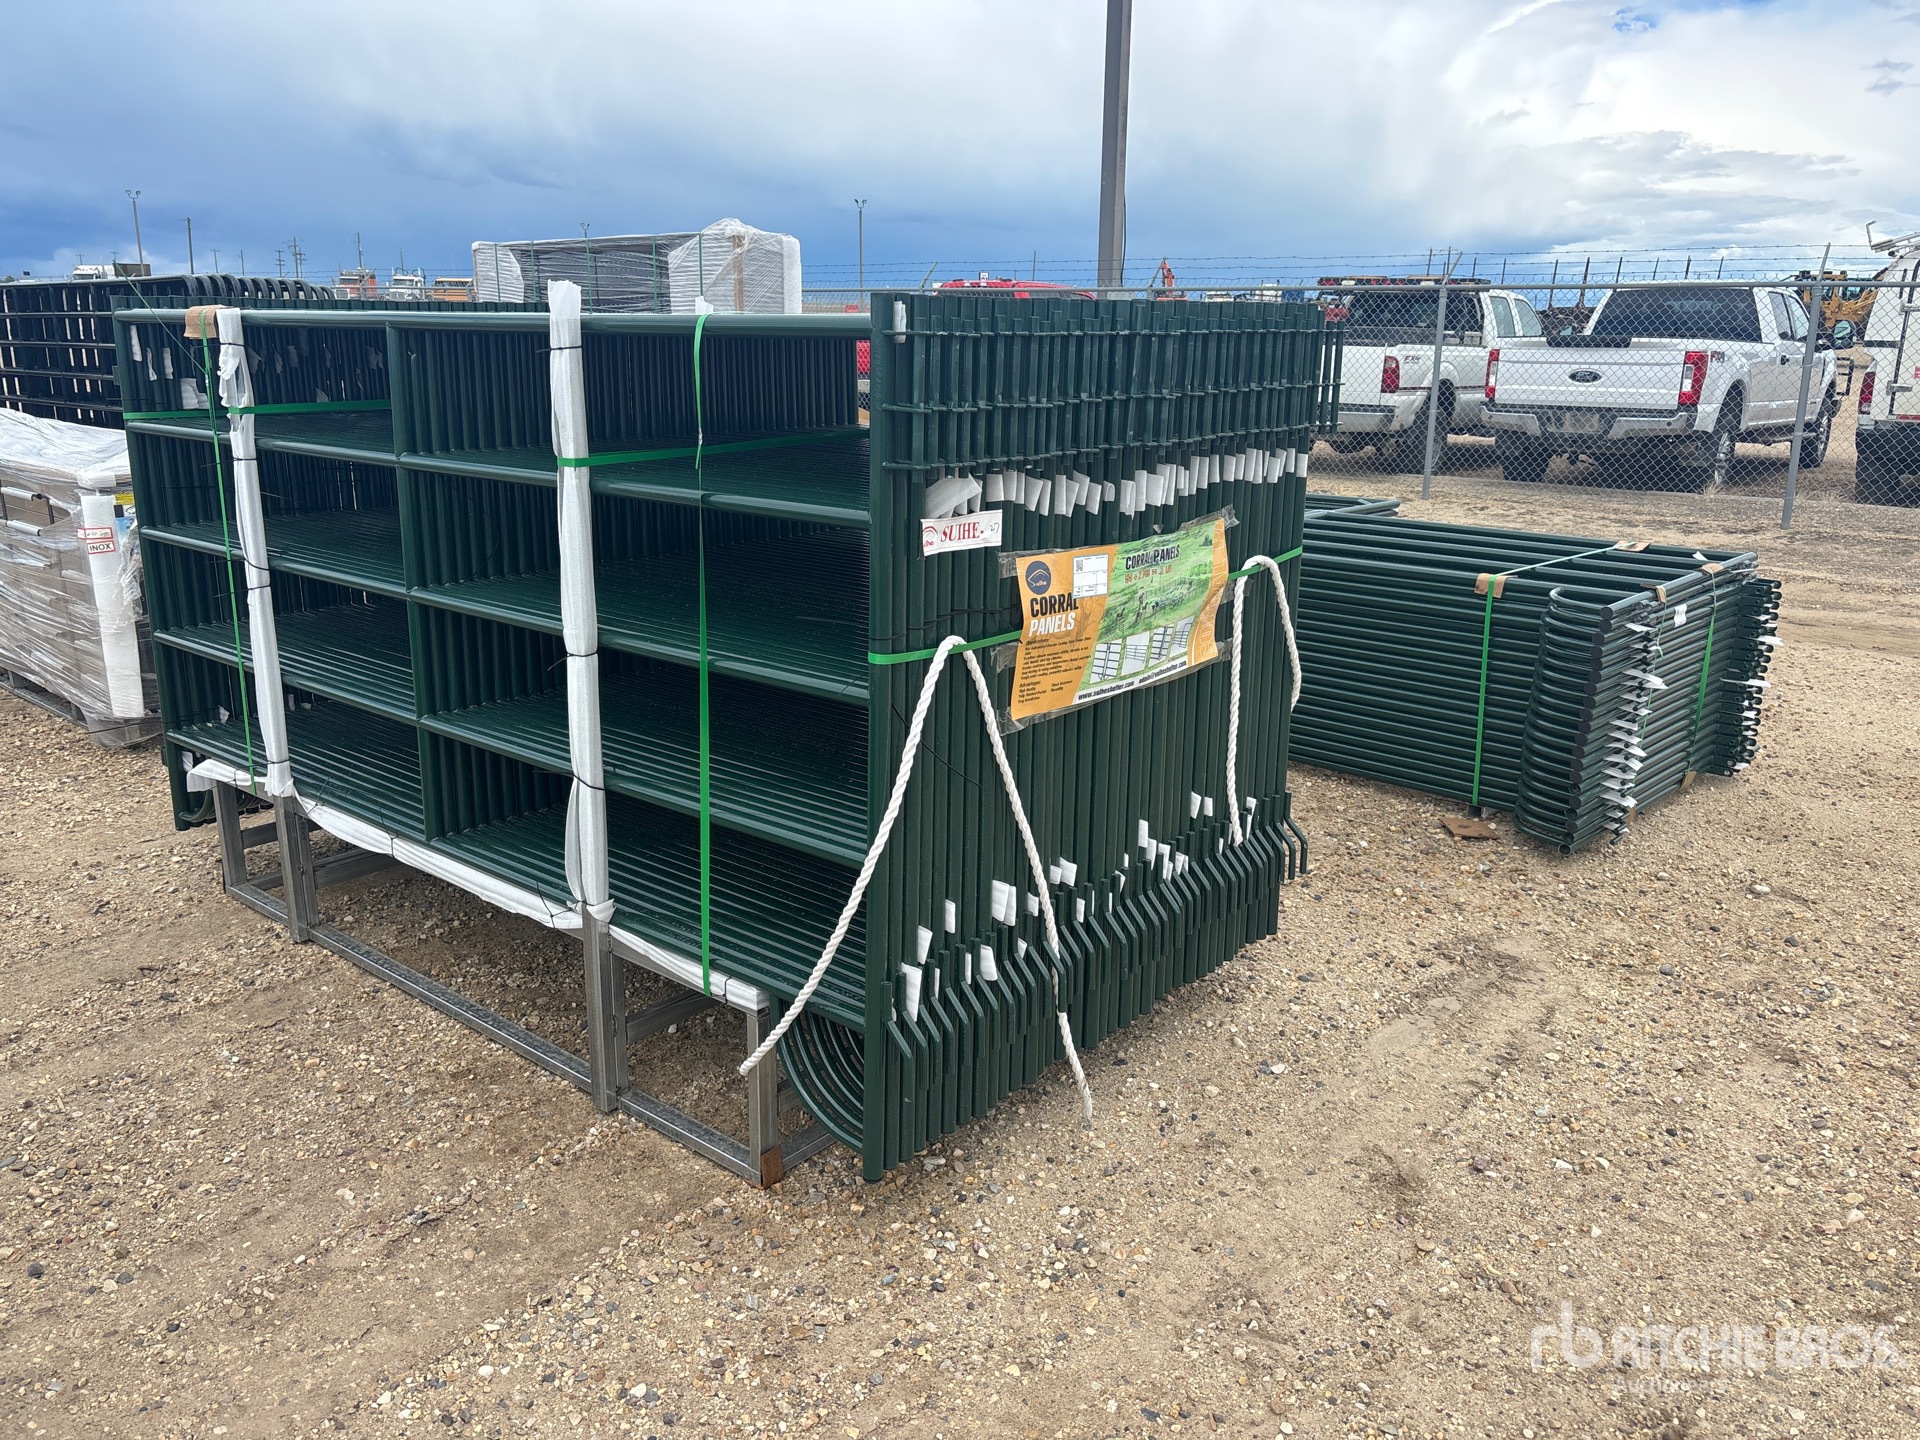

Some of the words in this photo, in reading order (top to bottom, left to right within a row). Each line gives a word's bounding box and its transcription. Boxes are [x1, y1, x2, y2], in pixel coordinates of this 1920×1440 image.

[89, 542, 112, 552] INOX
[1153, 545, 1181, 563] PANELS
[1030, 592, 1079, 618] CORRAL
[1028, 612, 1076, 637] PANELS
